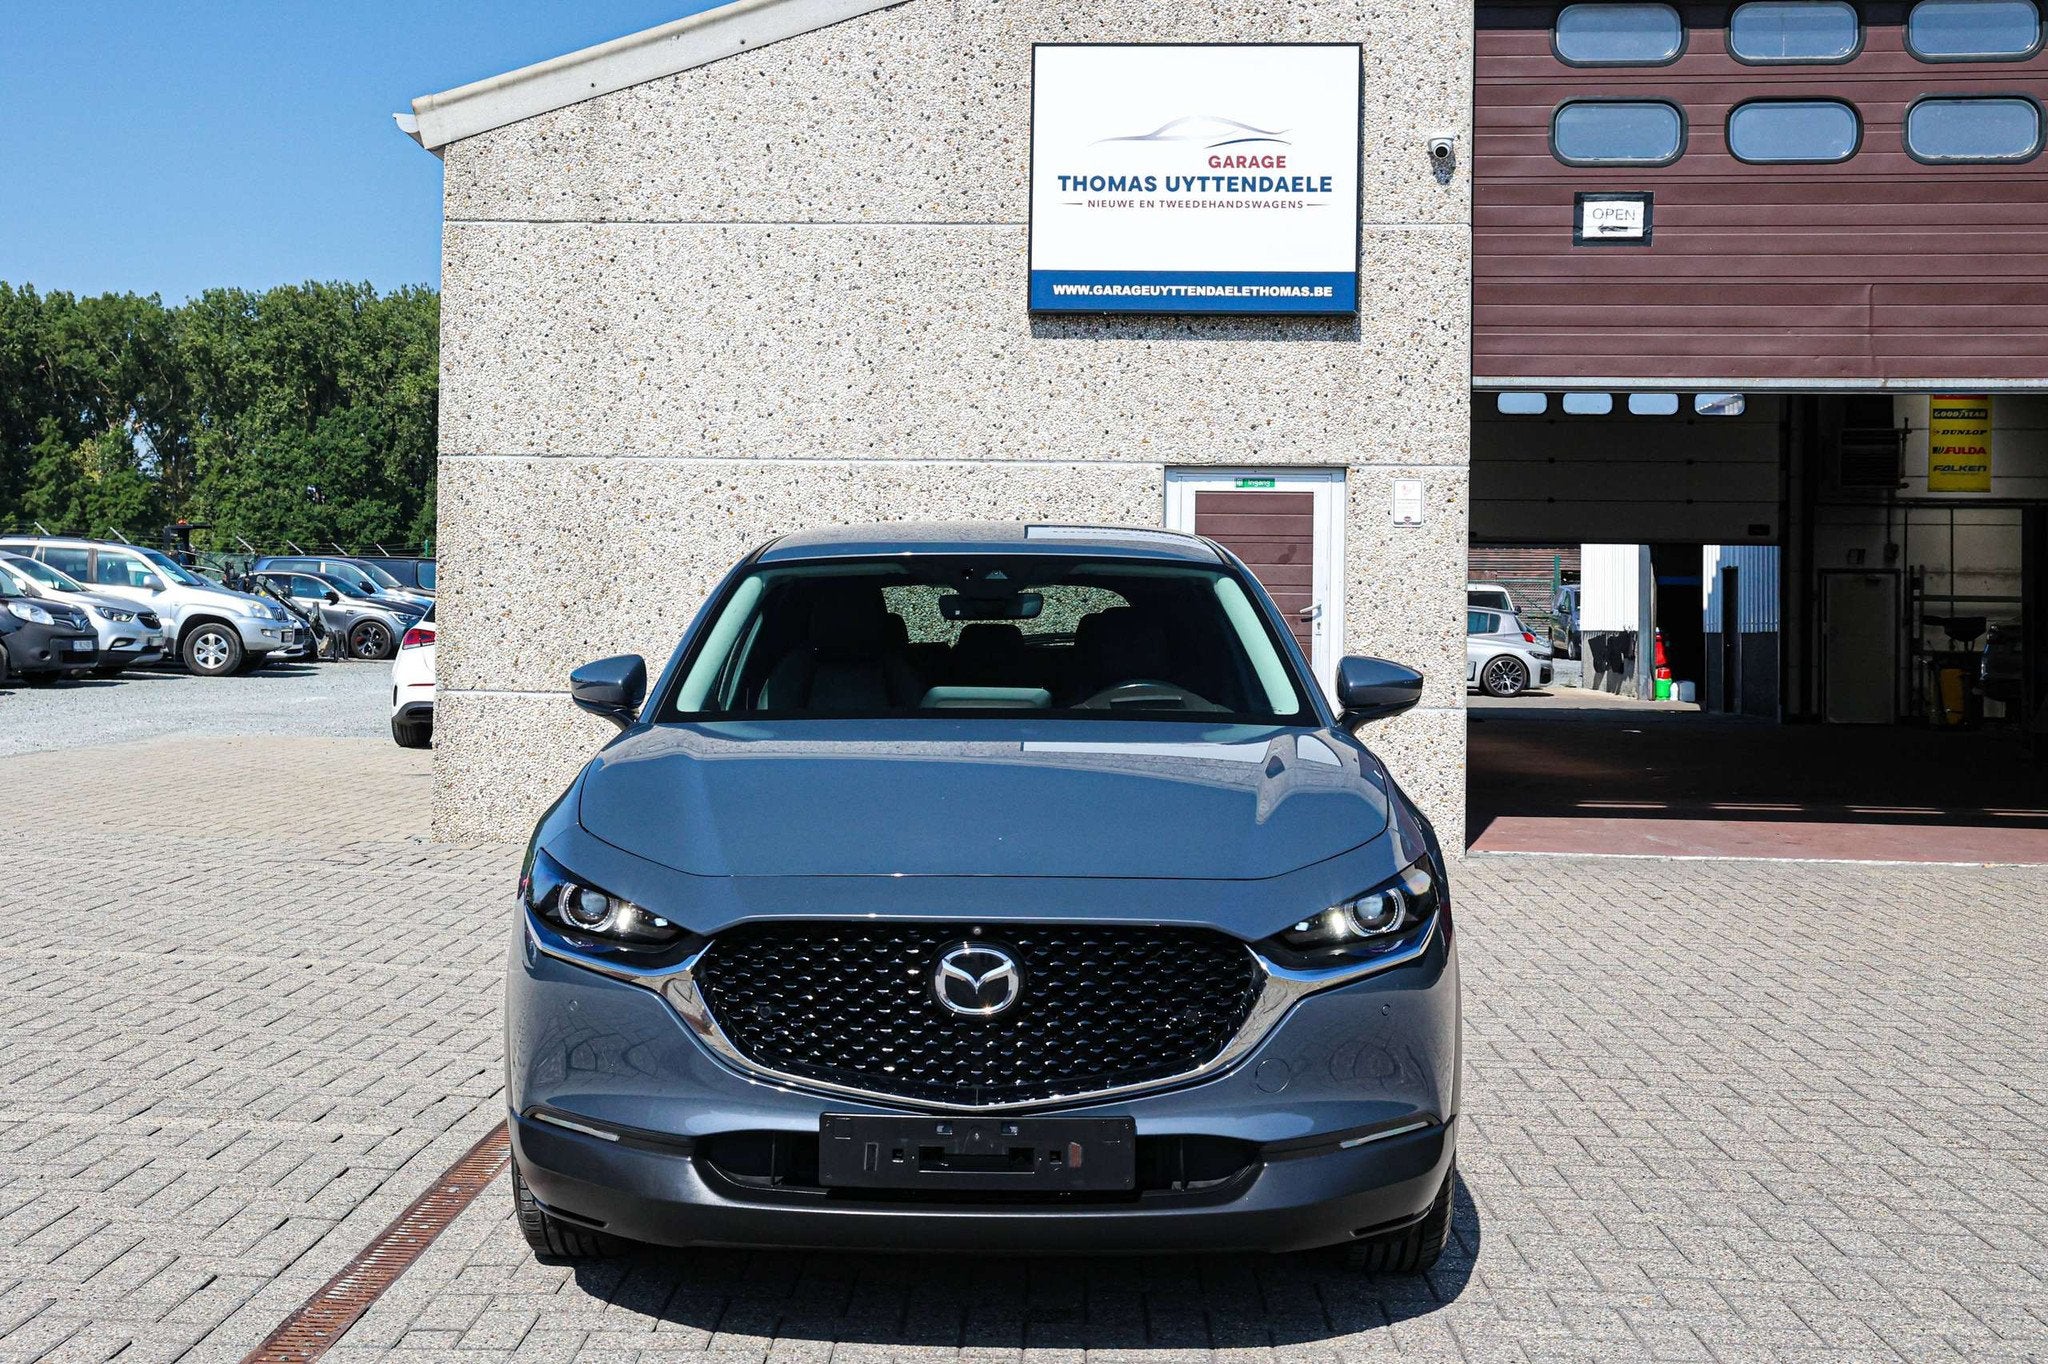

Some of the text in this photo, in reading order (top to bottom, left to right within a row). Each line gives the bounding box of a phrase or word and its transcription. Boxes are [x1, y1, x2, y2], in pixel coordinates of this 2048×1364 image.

[1208, 155, 1287, 169] GARAGE
[1057, 175, 1333, 193] THOMAS UYTTENDAELE
[1087, 199, 1304, 209] NIEUWE EN TWEEDEHANDSWAGENS
[1592, 207, 1636, 221] OPEN
[1053, 284, 1333, 298] WWW.GARAGEUYTTENDAELETHOMAS.BE
[1934, 409, 1987, 418] GOODYEAR
[1943, 446, 1988, 455] FULDA
[1932, 464, 1988, 472] FALKEN
